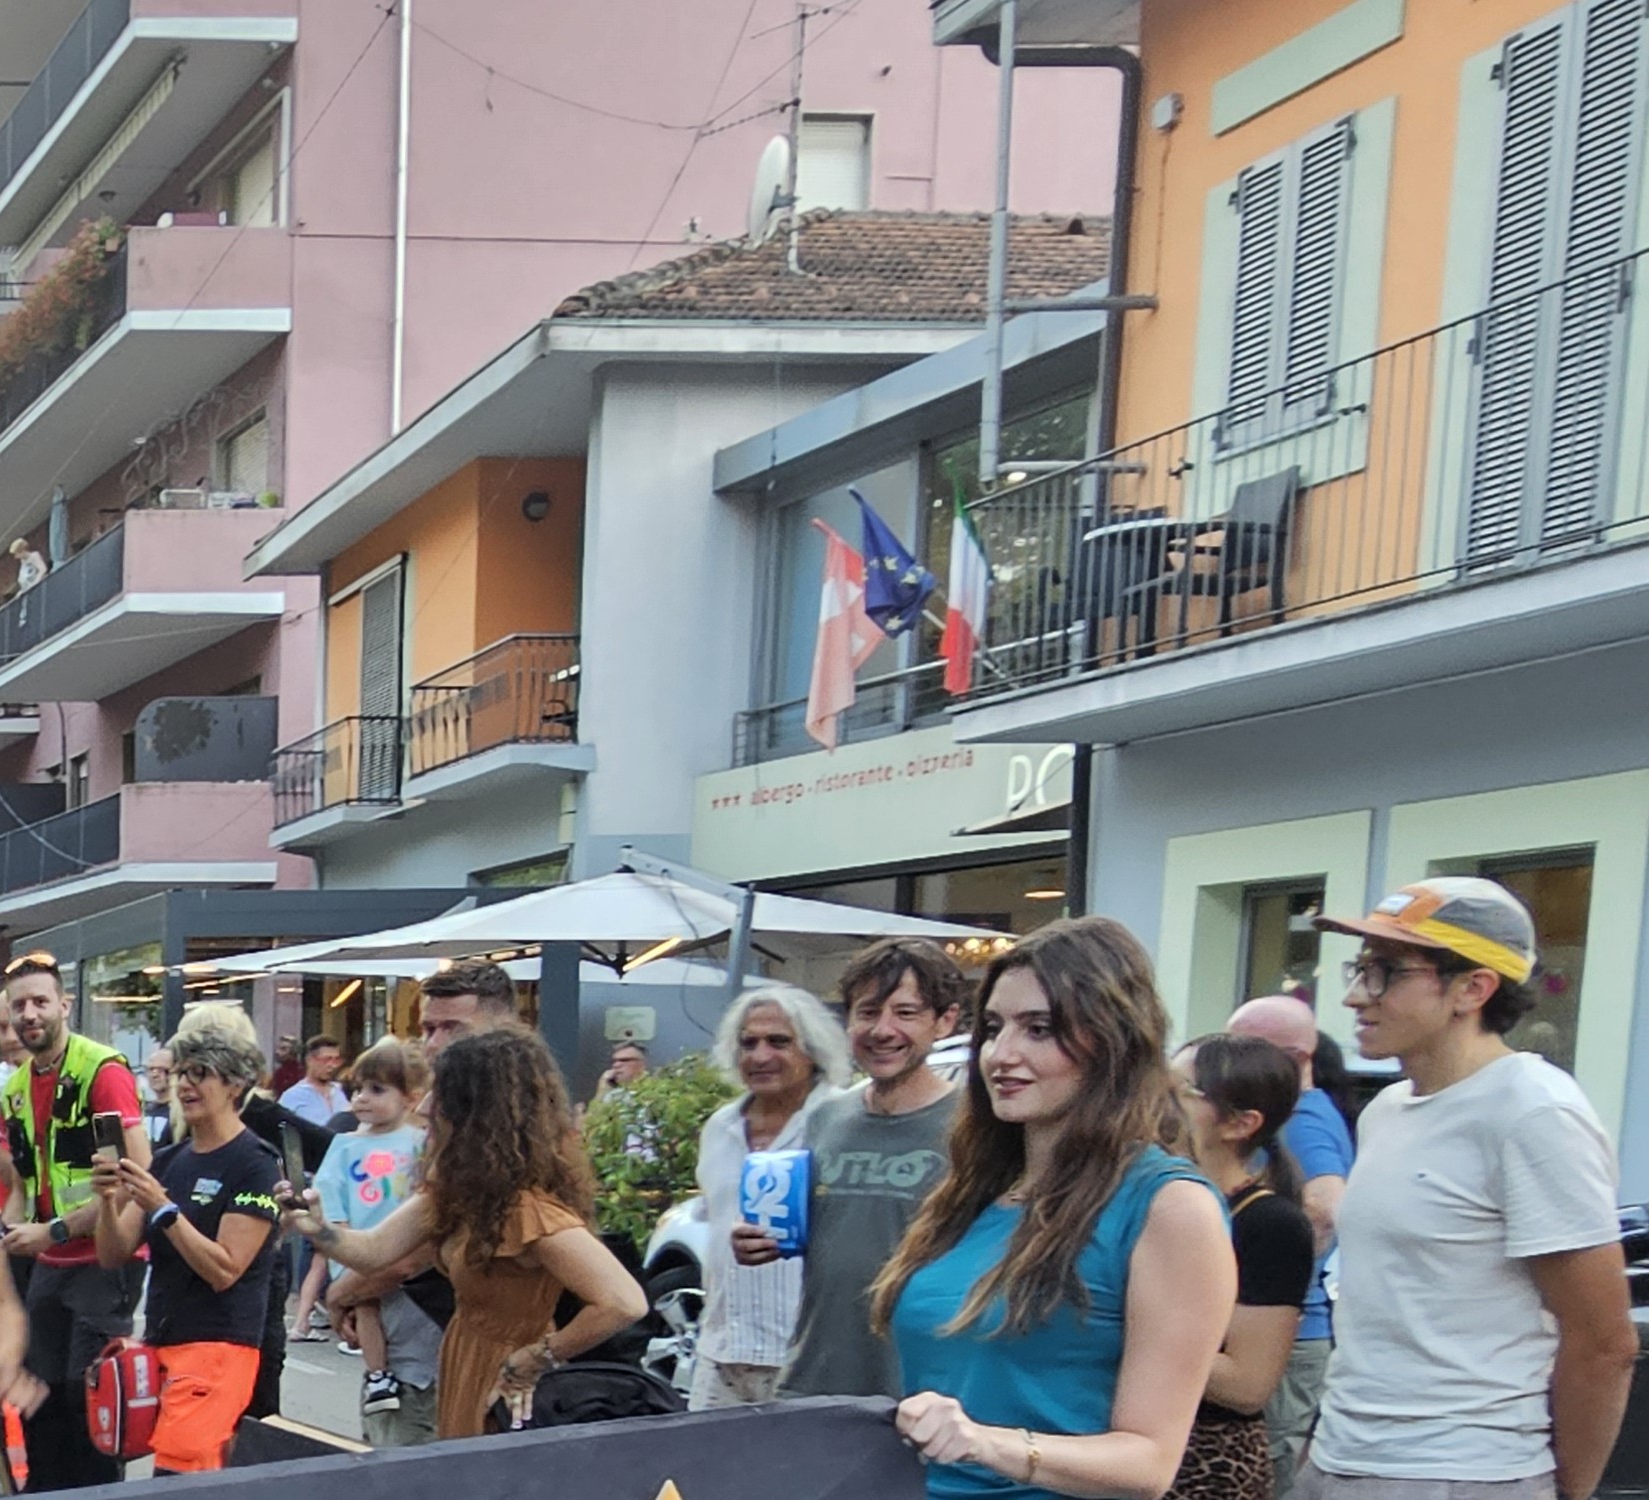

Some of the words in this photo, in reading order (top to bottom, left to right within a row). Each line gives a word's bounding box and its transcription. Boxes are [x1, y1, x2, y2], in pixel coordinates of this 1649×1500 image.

[750, 782, 804, 805] albergo
[814, 765, 894, 795] ristorante
[905, 749, 974, 779] pizzeria
